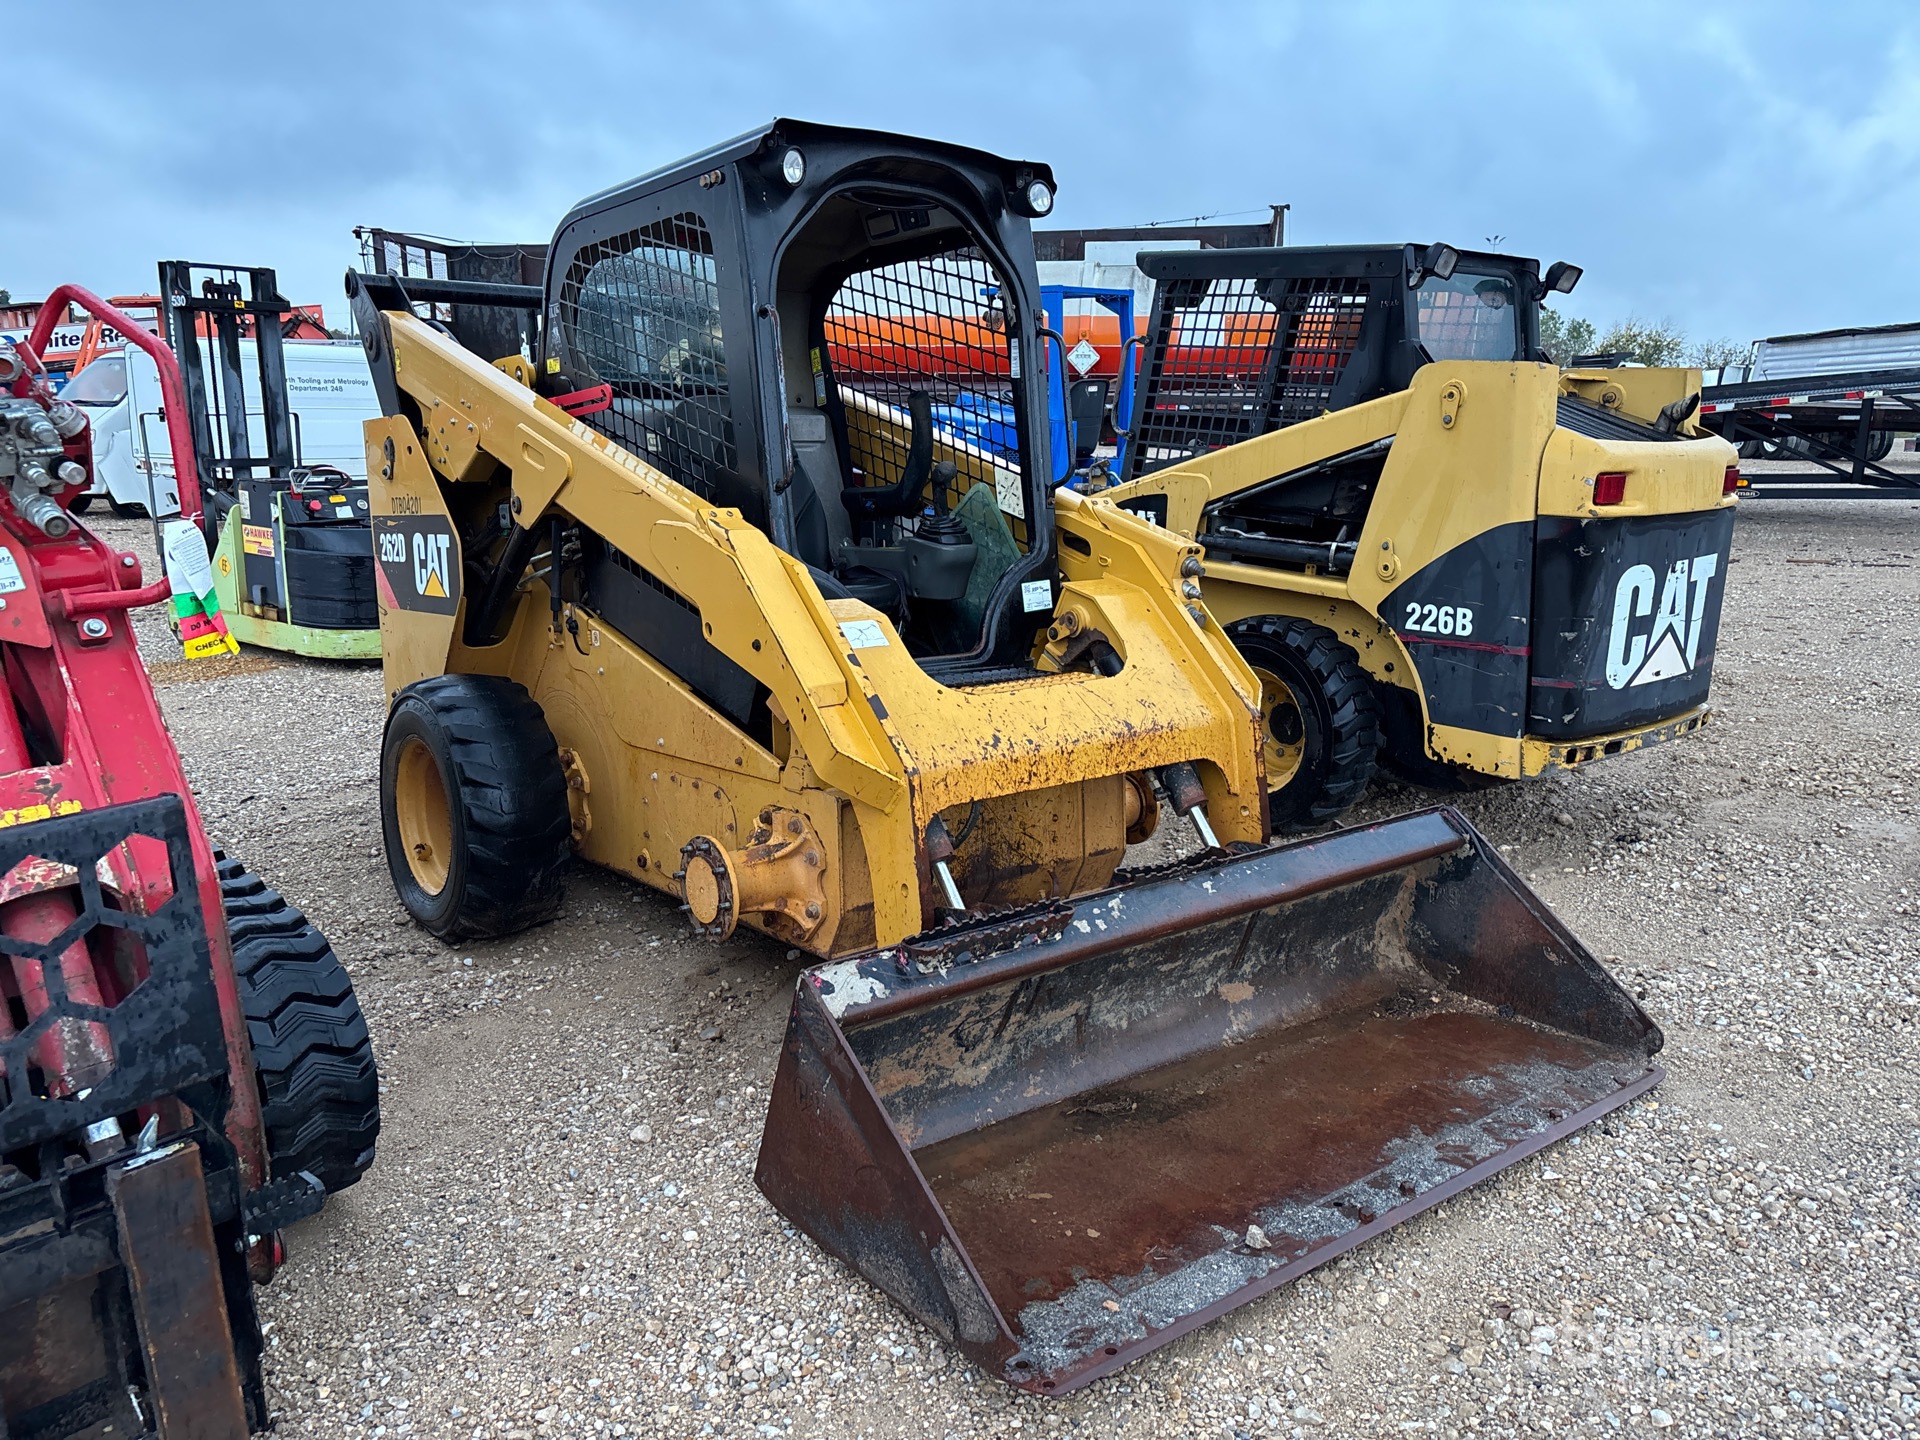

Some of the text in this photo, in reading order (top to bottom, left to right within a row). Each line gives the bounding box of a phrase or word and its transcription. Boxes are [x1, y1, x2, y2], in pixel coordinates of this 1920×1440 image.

[171, 295, 187, 307] 530
[297, 377, 321, 385] Tooling
[337, 378, 369, 386] Metrology
[379, 532, 406, 563] 262D
[412, 532, 450, 598] CAT
[190, 622, 201, 631] DO
[1404, 601, 1473, 637] 226B
[1605, 552, 1719, 691] CAT
[195, 637, 226, 652] CHECK
